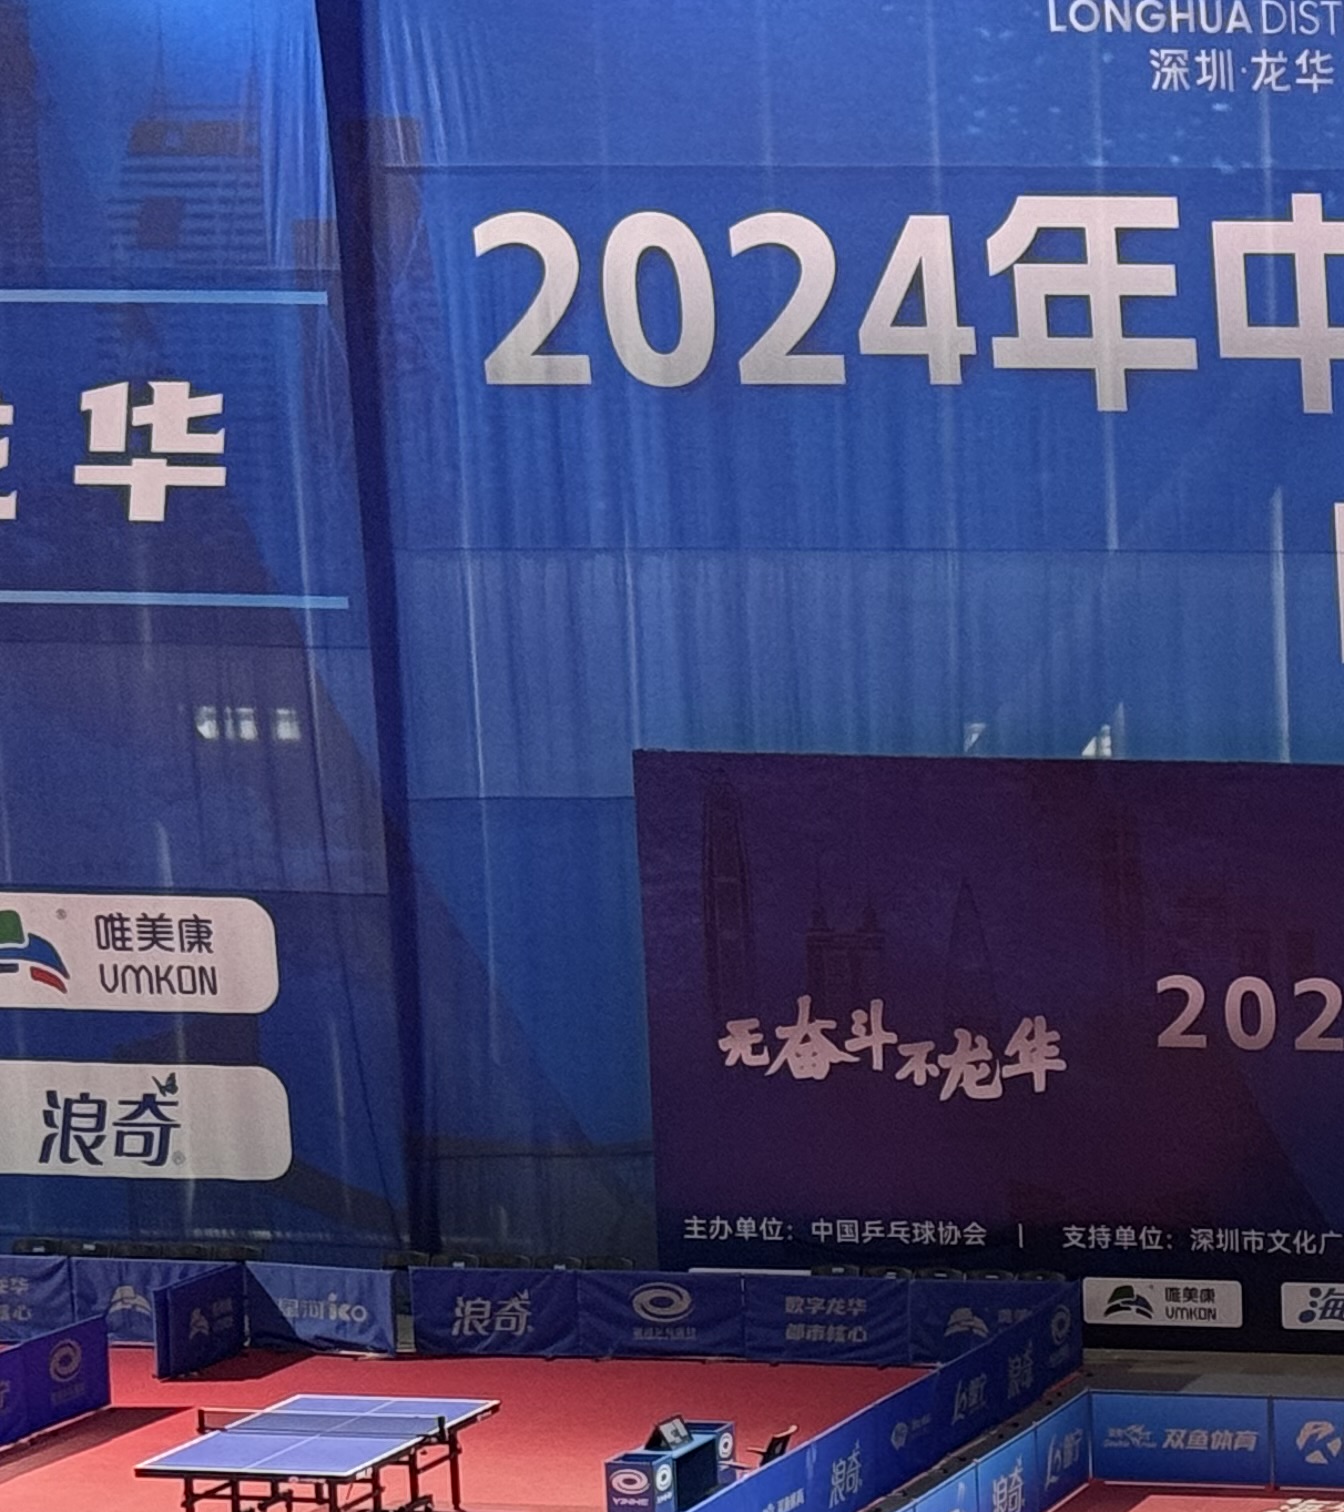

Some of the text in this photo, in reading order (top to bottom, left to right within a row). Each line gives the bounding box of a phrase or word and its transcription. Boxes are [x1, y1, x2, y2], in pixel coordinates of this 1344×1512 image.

[1049, 0, 1251, 34] LONGHUA
[1150, 48, 1334, 92] 深圳·龙华
[0, 380, 227, 522] 华
[94, 913, 214, 954] 唯美康
[718, 995, 1067, 1102] 无奋斗不龙华
[38, 1090, 182, 1167] 浪奇
[451, 1292, 533, 1337] 浪奇
[1162, 1427, 1260, 1453] 双鱼体育
